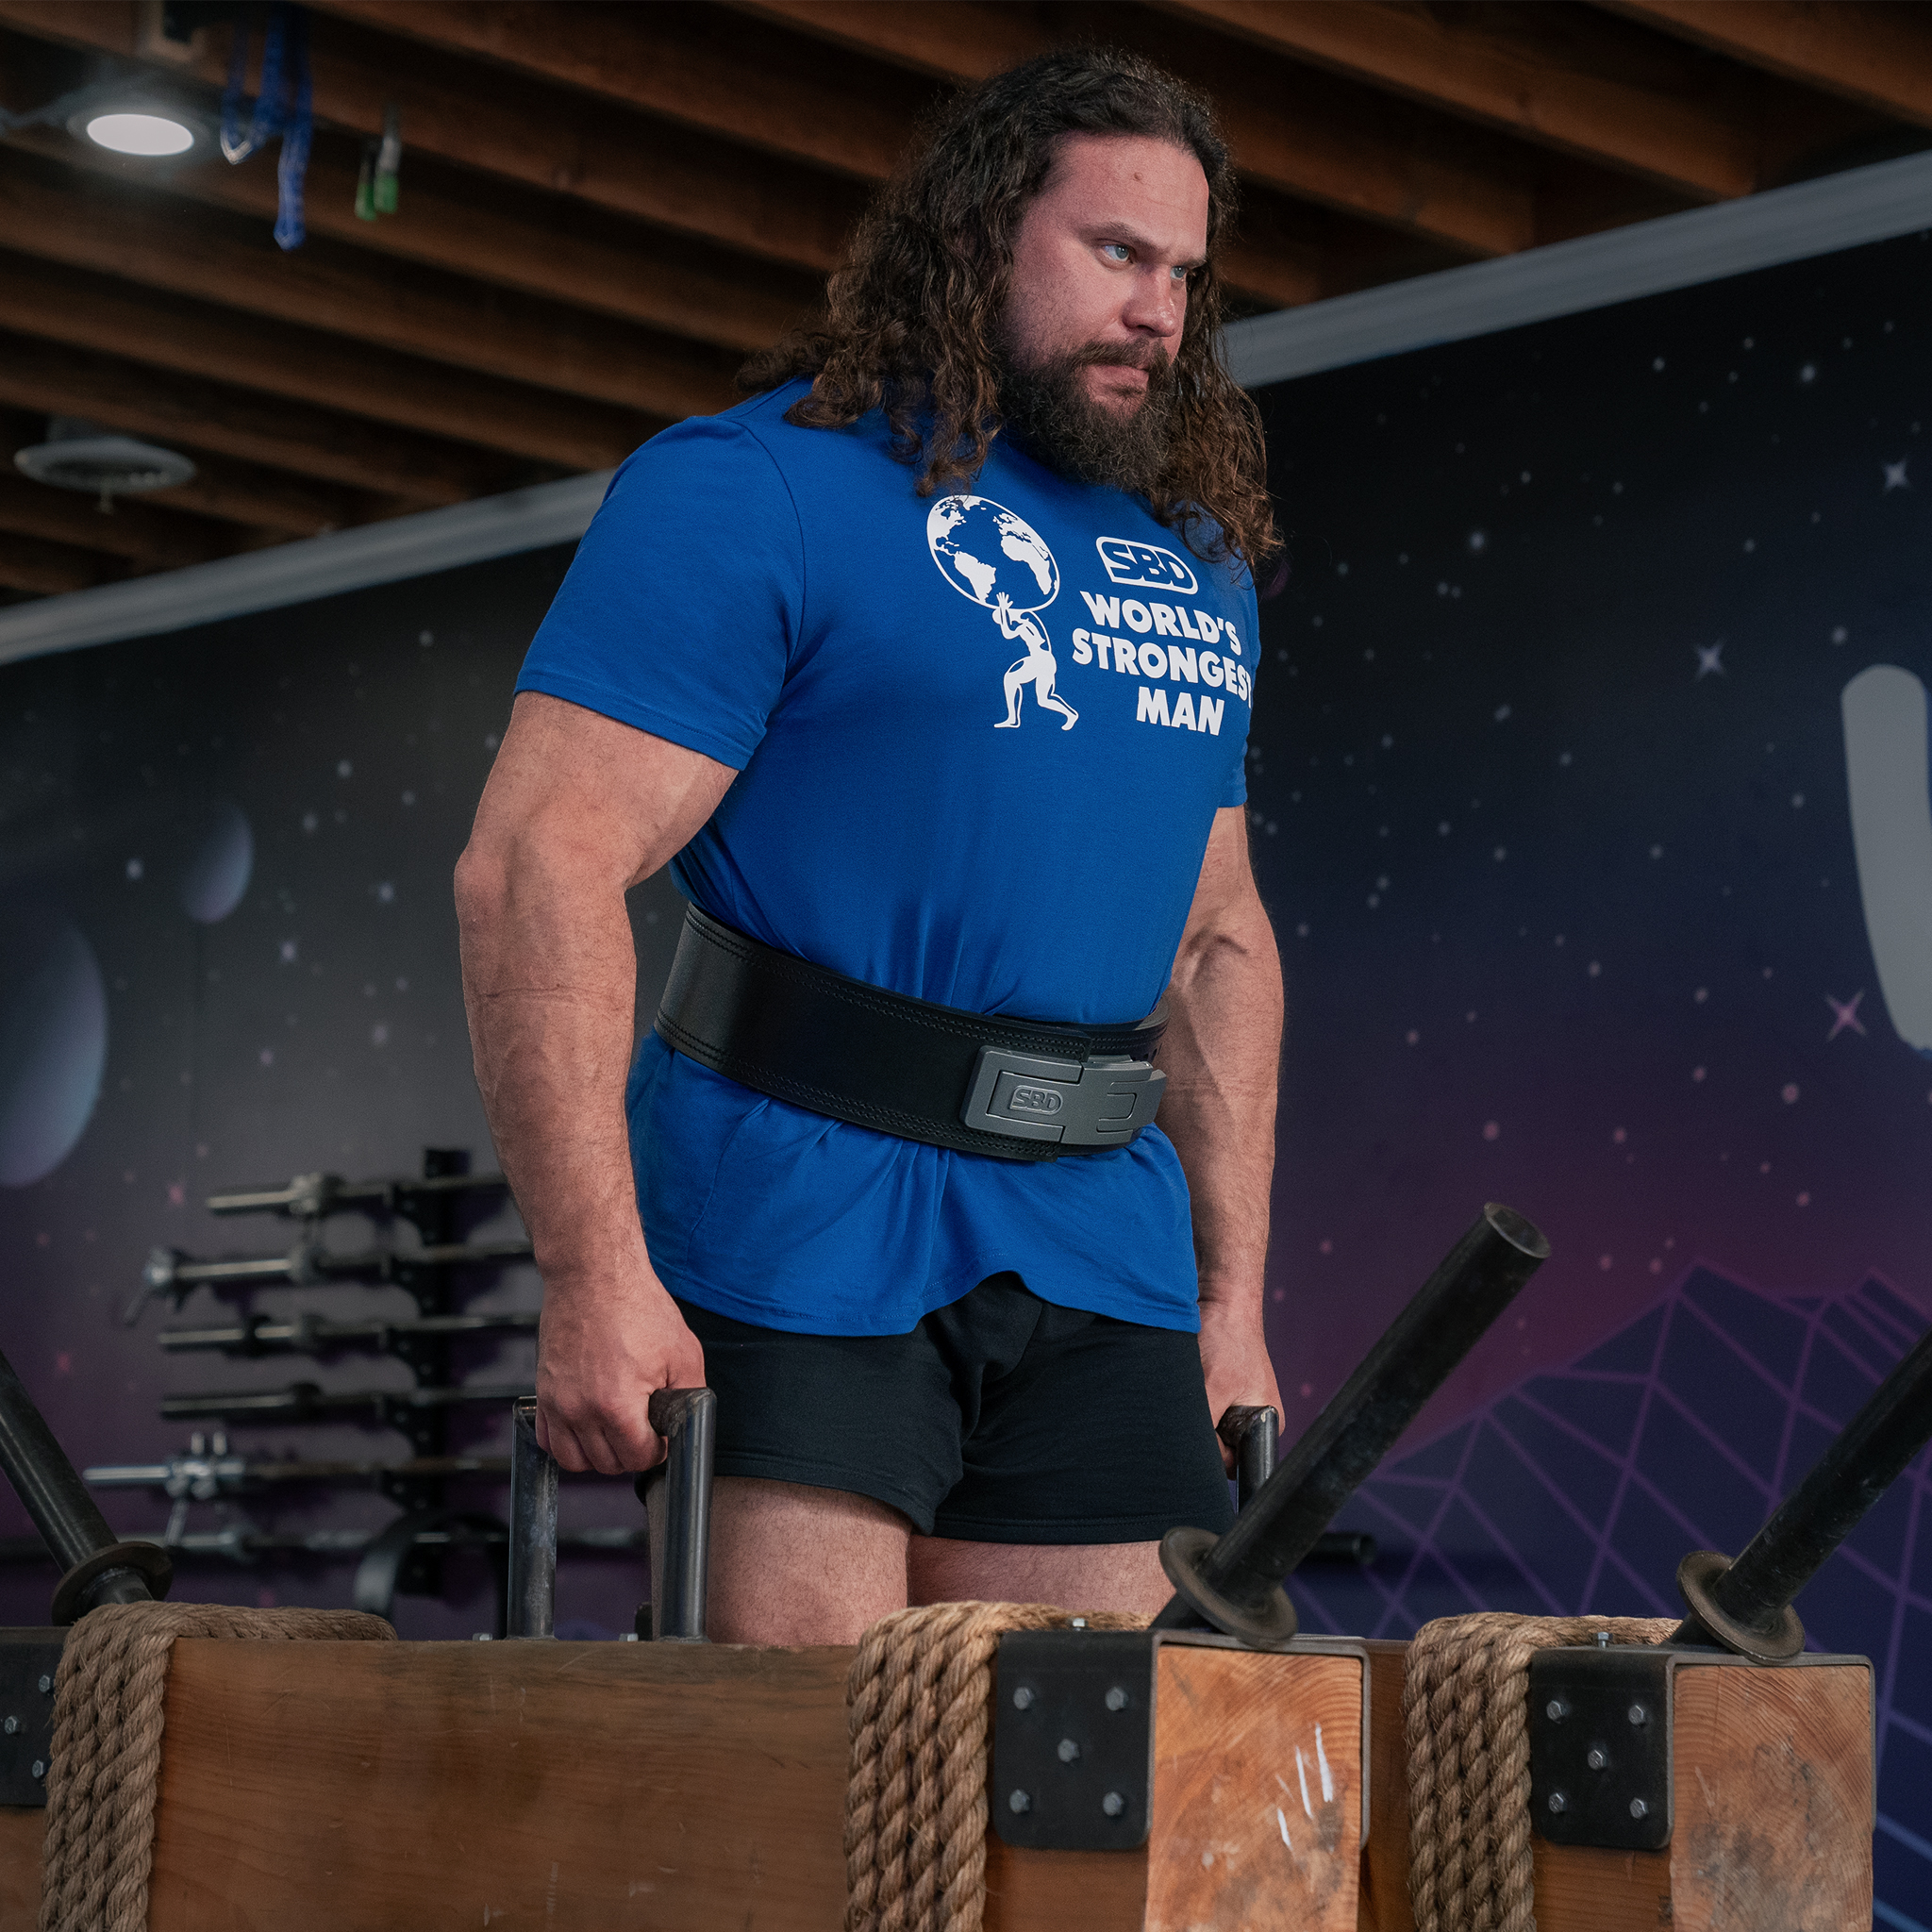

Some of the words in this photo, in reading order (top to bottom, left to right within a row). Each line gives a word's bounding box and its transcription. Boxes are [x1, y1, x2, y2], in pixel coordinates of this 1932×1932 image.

[1099, 540, 1196, 591] SBD
[1080, 591, 1241, 656] WORLD'S
[1137, 686, 1224, 736] MAN
[1011, 1088, 1062, 1113] SBD
